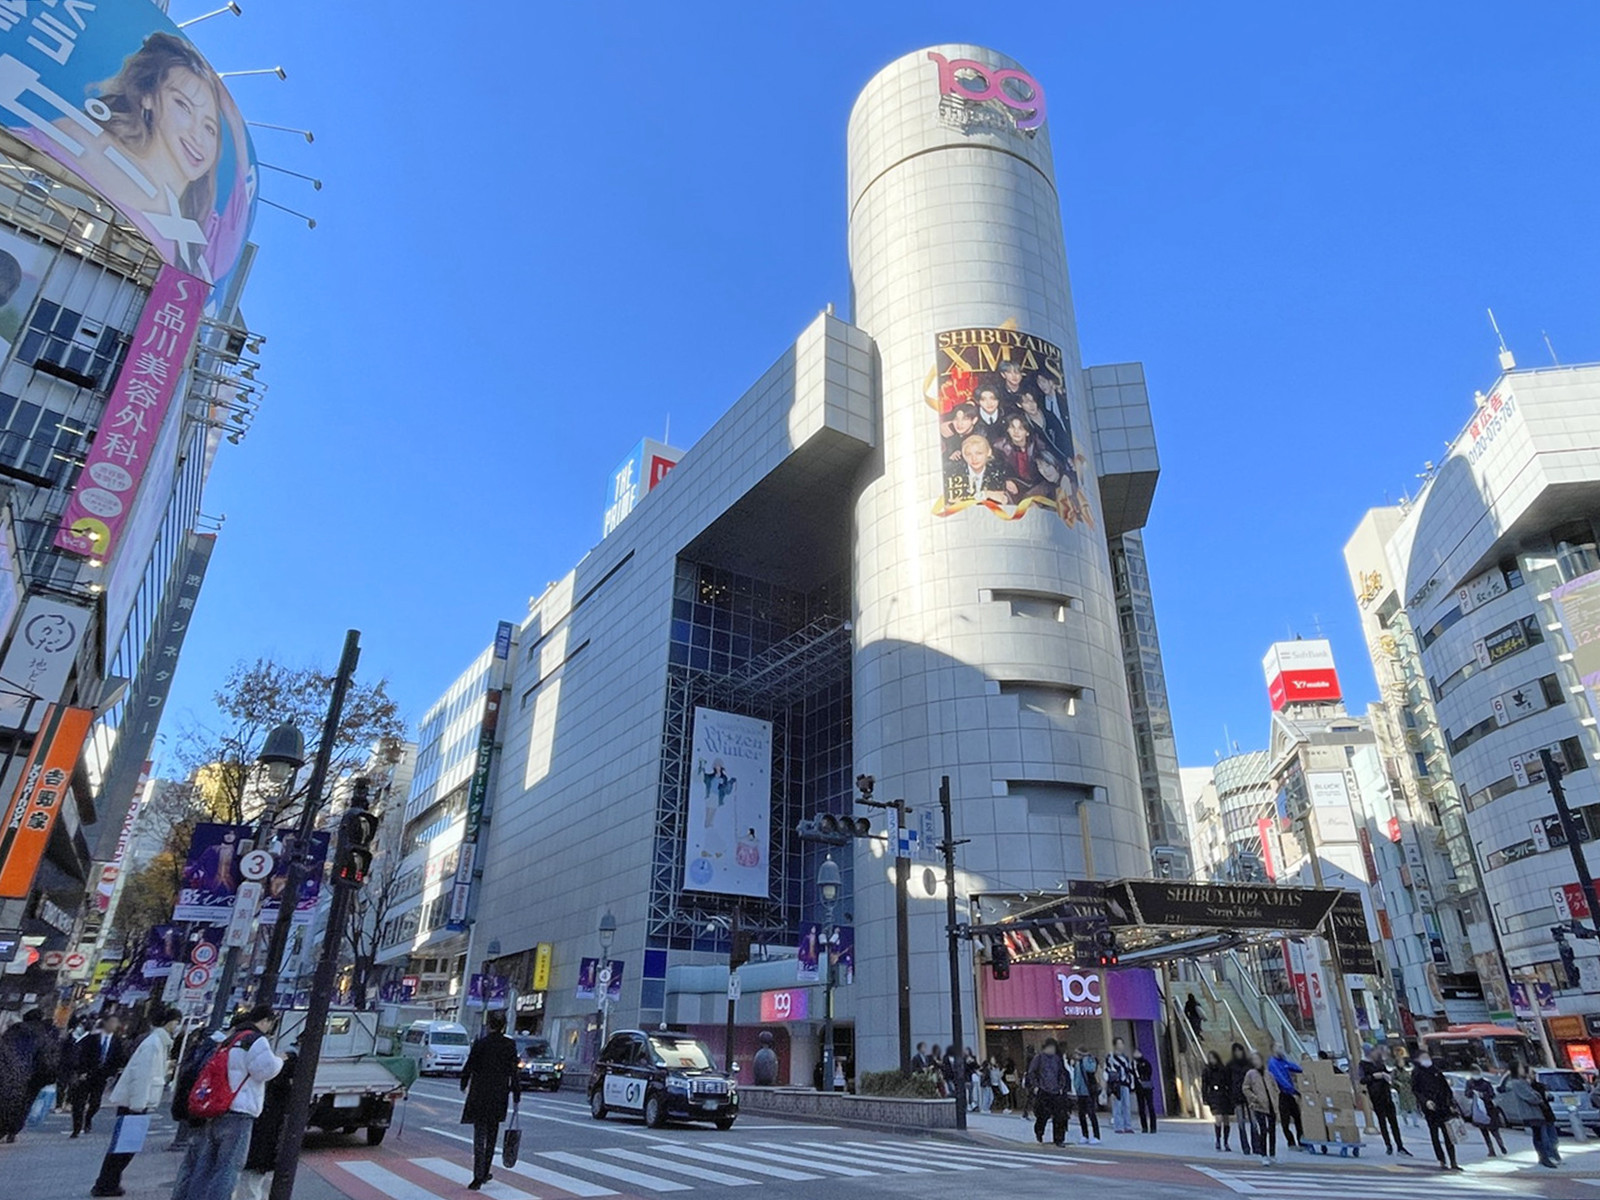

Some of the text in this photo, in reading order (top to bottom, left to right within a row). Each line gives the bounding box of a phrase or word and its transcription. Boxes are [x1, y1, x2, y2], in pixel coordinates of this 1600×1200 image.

[927, 51, 1046, 130] 109
[938, 328, 1061, 360] SHIBUYA109
[102, 302, 187, 467] 品川美容外科
[1469, 393, 1503, 441] 貸広告
[248, 854, 266, 875] 3
